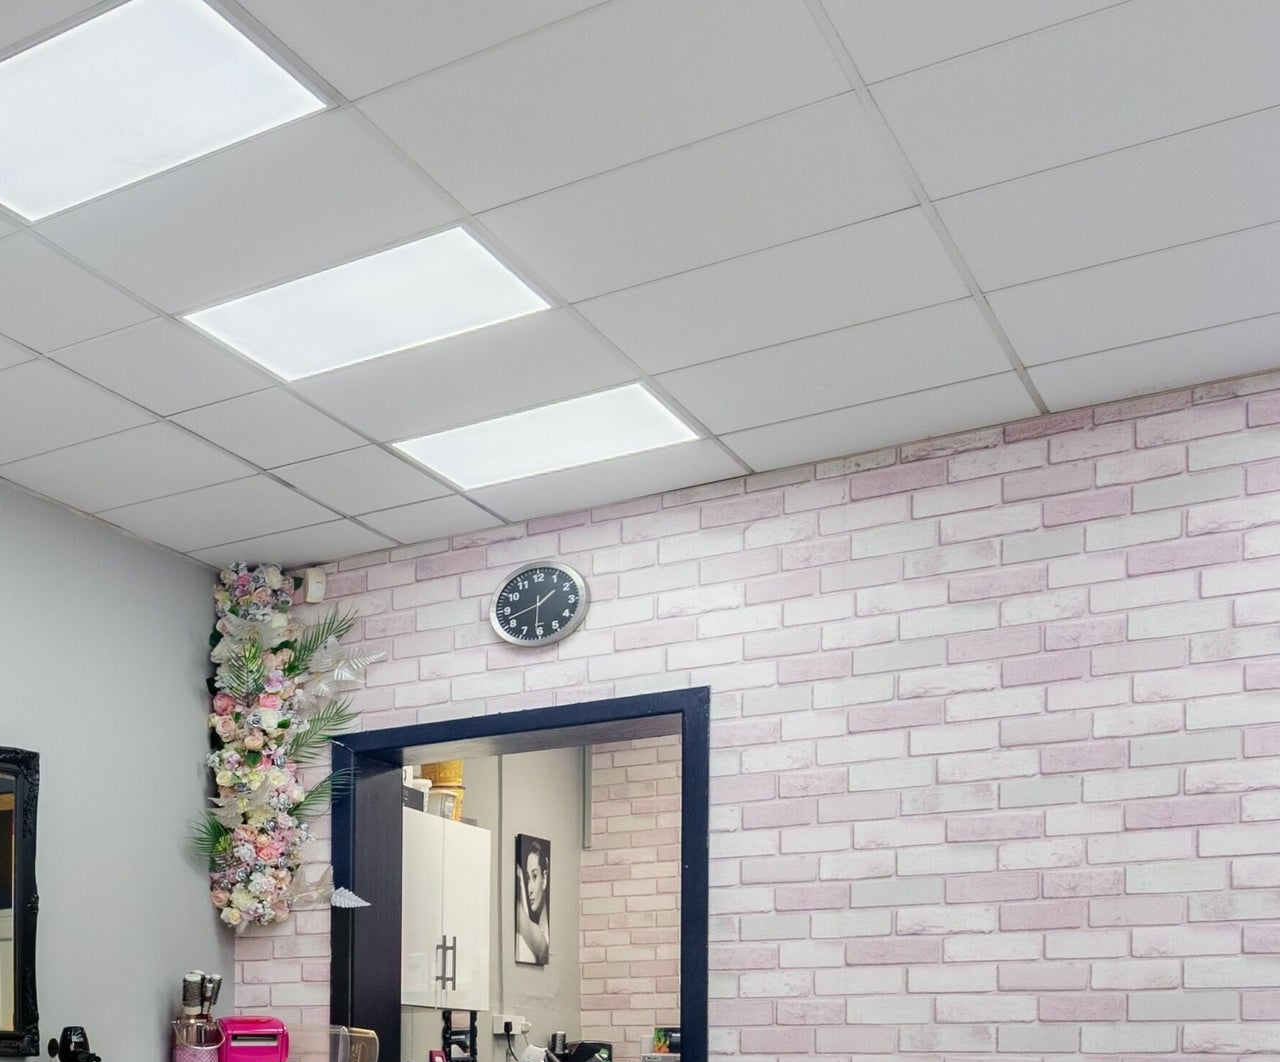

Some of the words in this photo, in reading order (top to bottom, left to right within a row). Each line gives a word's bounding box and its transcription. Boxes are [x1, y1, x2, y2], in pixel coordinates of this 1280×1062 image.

[532, 573, 545, 582] 12
[552, 575, 558, 583] 1
[517, 581, 529, 590] 11
[562, 582, 570, 591] 2
[508, 593, 520, 601] 10
[568, 595, 575, 603] 3
[504, 607, 512, 615] 9
[562, 609, 570, 617] 4
[510, 620, 517, 628] 8
[552, 621, 559, 629] 5
[521, 626, 528, 635] 7
[536, 627, 544, 635] 6
